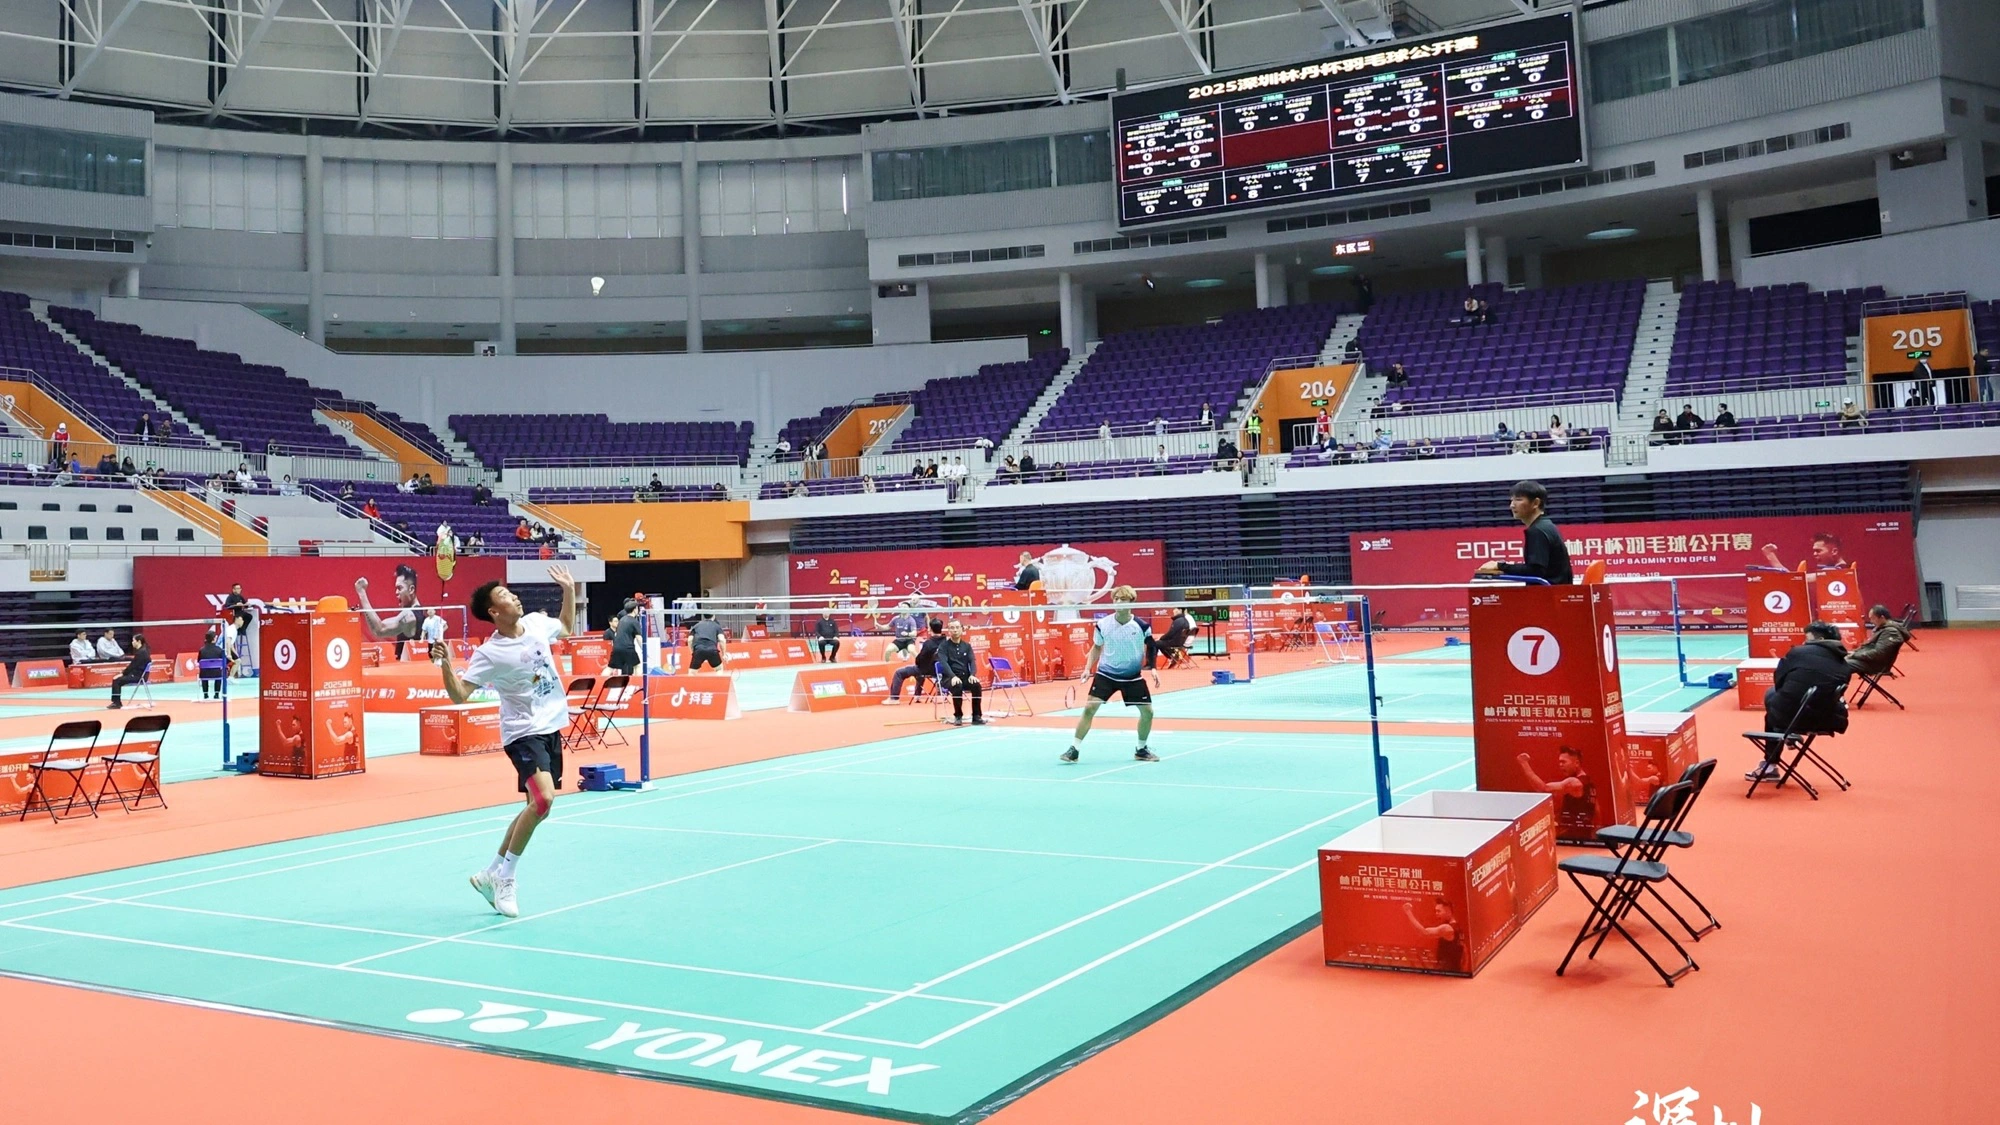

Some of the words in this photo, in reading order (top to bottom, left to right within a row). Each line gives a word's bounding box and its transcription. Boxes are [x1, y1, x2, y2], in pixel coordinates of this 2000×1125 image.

[1188, 35, 1479, 99] 2025深圳林丹杯羽毛球公开赛
[1470, 82, 1483, 92] 0
[1528, 72, 1541, 82] 0
[1354, 102, 1364, 112] 5
[1402, 93, 1424, 103] 12
[1244, 122, 1254, 130] 0
[1294, 112, 1305, 122] 0
[1354, 118, 1365, 127] 0
[1408, 108, 1420, 118] 0
[1473, 119, 1485, 129] 0
[1531, 110, 1544, 119] 0
[1138, 138, 1156, 148] 16
[1185, 130, 1204, 140] 10
[1355, 132, 1366, 142] 0
[1409, 124, 1421, 133] 0
[1142, 153, 1152, 161] 0
[1189, 145, 1200, 154] 0
[1143, 167, 1153, 175] 0
[1190, 159, 1200, 168] 0
[1358, 173, 1368, 182] 7
[1412, 165, 1423, 174] 7
[1248, 190, 1258, 199] 8
[1299, 182, 1307, 191] 1
[1145, 205, 1155, 214] 0
[1192, 198, 1202, 207] 0
[1335, 242, 1356, 255] 东区
[1892, 326, 1942, 350] 205
[1300, 380, 1336, 399] 206
[630, 519, 646, 542] 4
[1456, 540, 1523, 559] 2025
[1627, 556, 1687, 564] BADMINTON
[829, 569, 839, 584] 2
[943, 566, 954, 581] 2
[976, 574, 986, 590] 5
[860, 580, 869, 595] 5
[1833, 584, 1840, 592] 4
[1772, 595, 1783, 609] 2
[1218, 610, 1228, 619] 10
[281, 644, 290, 664] 9
[334, 644, 342, 662] 9
[1522, 635, 1545, 666] 7
[689, 692, 713, 705] 抖音
[1503, 695, 1570, 706] 2025深圳
[1358, 865, 1423, 879] 2025深圳
[584, 1021, 942, 1096] YONEX
